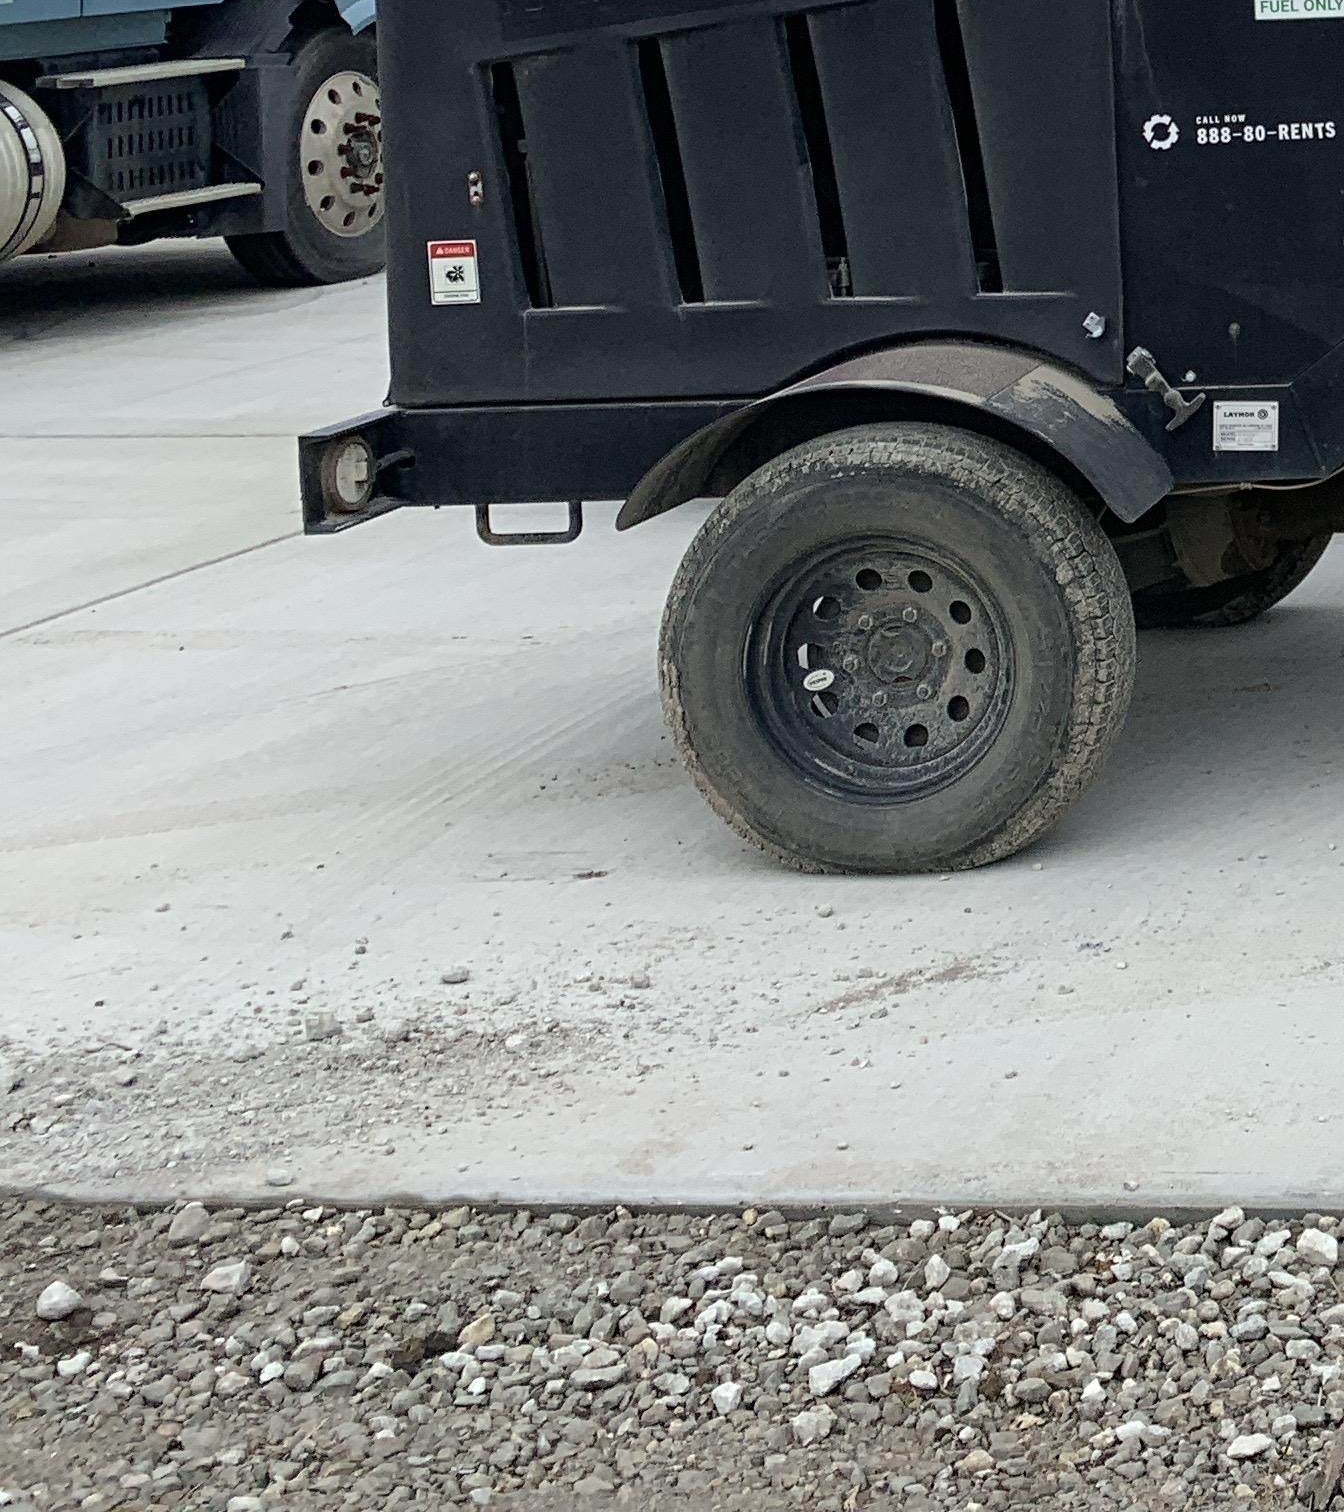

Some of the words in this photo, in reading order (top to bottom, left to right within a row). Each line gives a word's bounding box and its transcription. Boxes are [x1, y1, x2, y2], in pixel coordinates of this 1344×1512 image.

[1260, 0, 1299, 13] FUEL
[1195, 115, 1220, 125] CALL
[1224, 114, 1246, 123] NOW
[1196, 121, 1337, 145] 888-80-RENTS
